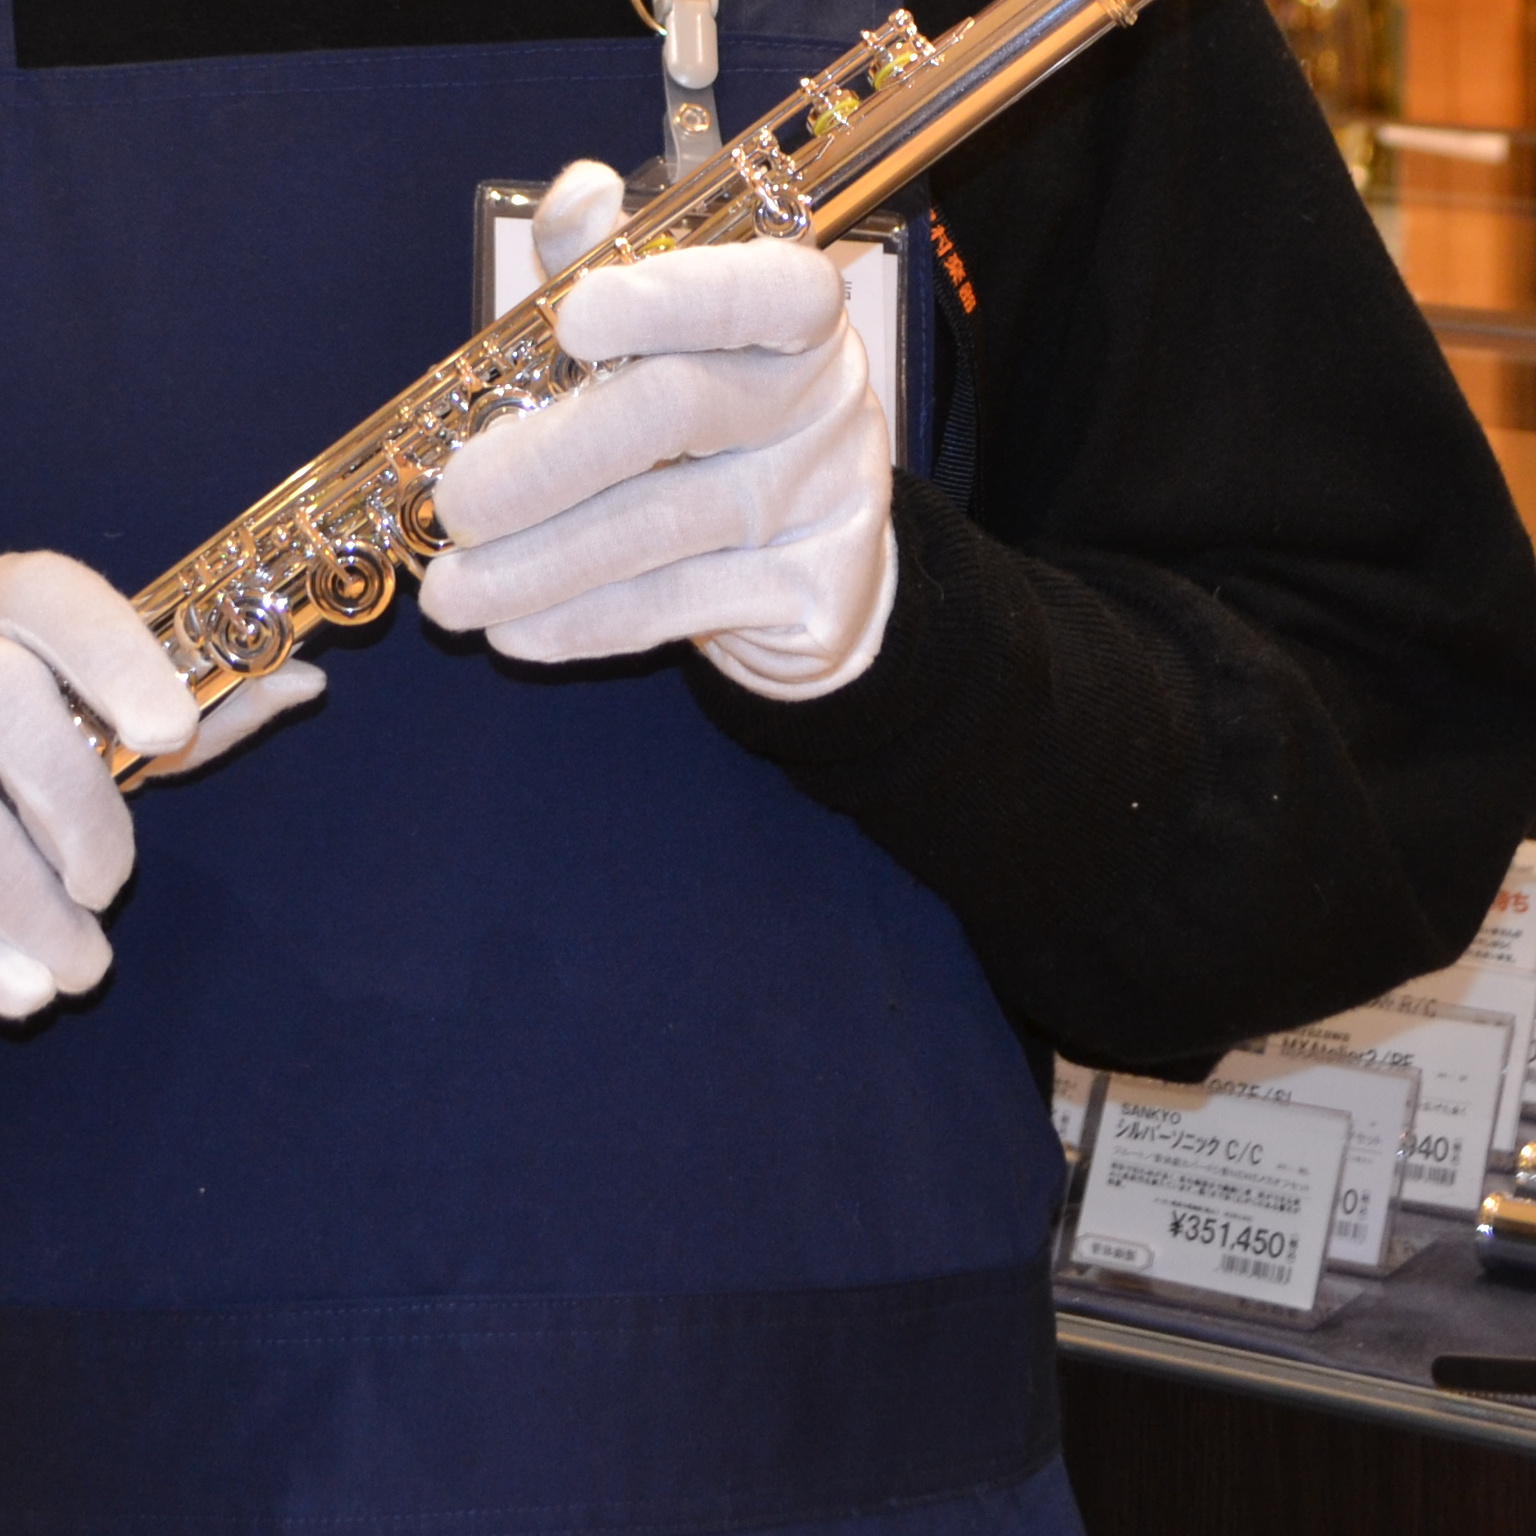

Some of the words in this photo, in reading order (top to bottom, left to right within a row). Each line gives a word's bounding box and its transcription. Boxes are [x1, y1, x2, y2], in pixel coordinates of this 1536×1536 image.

[1121, 1102, 1182, 1125] SANKYO
[1115, 1119, 1220, 1156] シルバーソニック
[1225, 1138, 1263, 1166] C/C
[1169, 1210, 1286, 1259] ¥351,450
